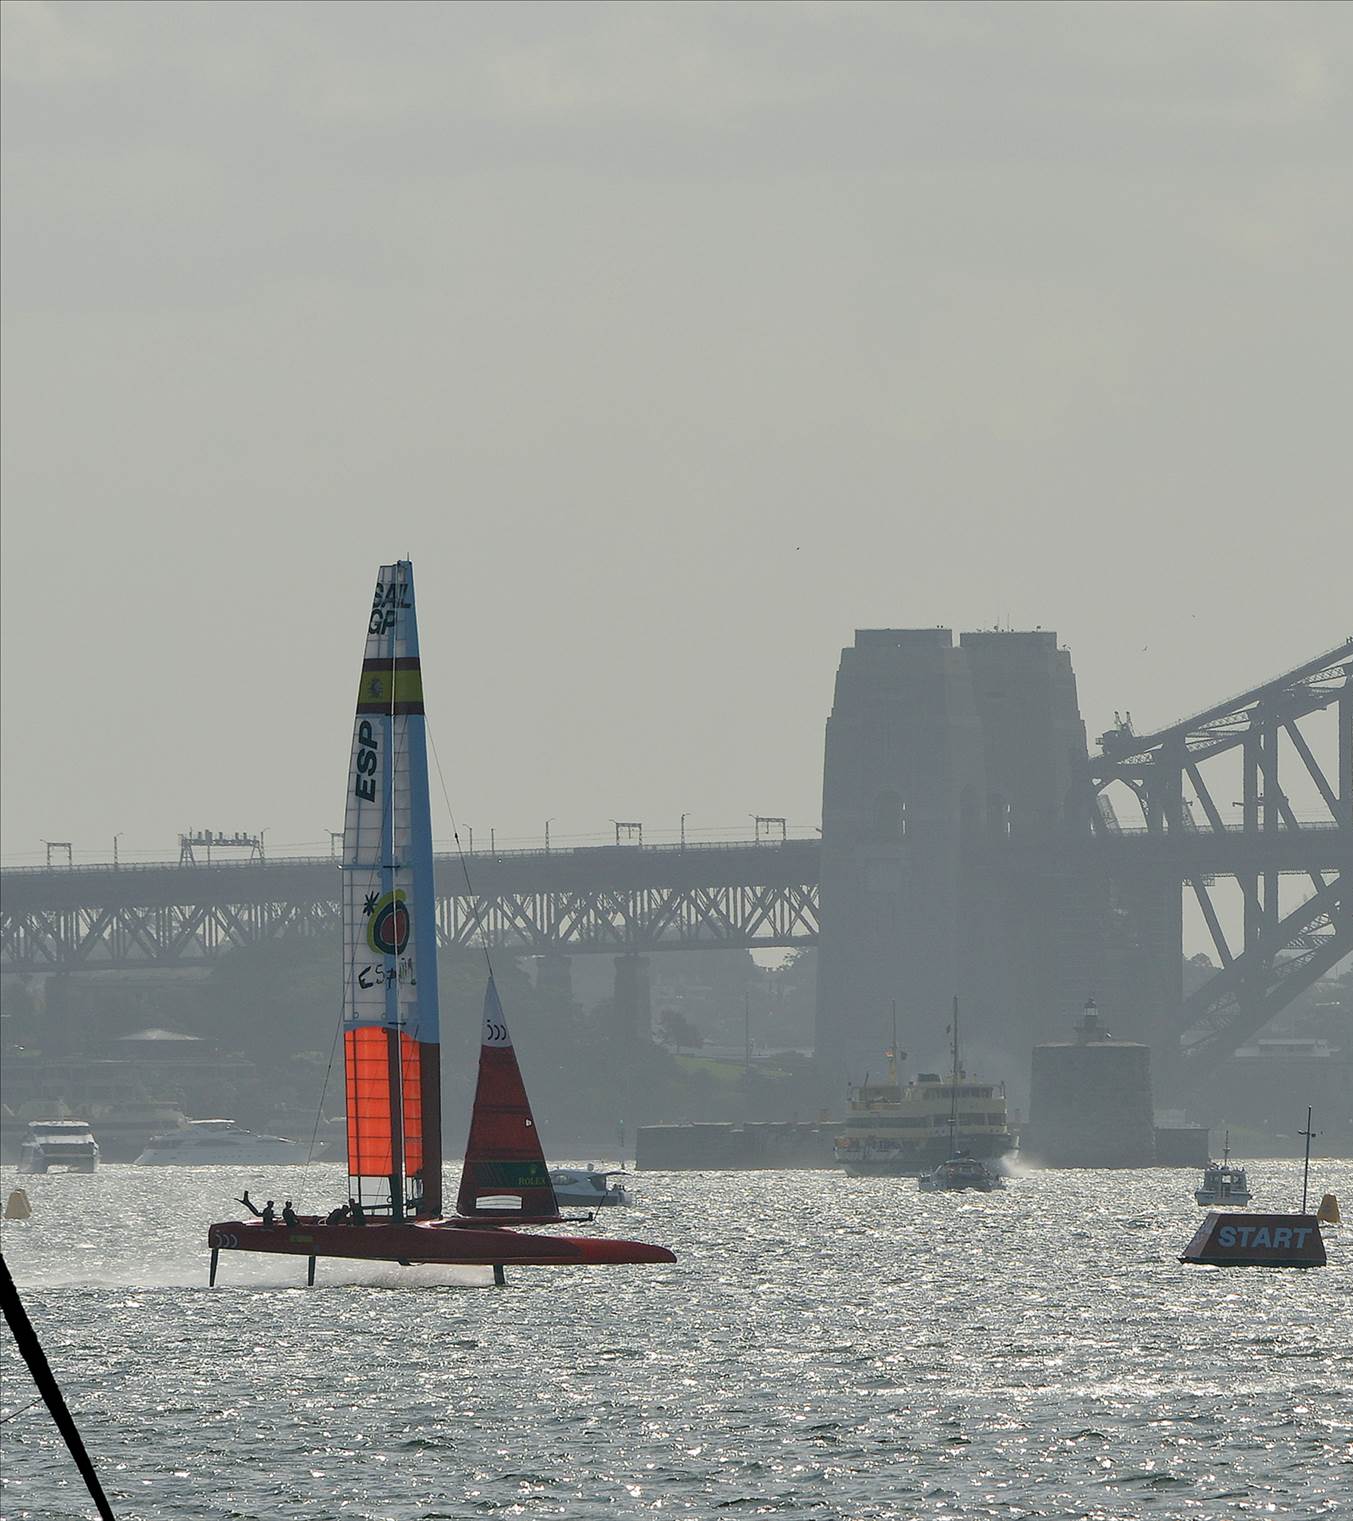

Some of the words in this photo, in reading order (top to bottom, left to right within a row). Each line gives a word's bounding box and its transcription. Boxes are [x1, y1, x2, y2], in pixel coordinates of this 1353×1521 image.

[372, 582, 412, 609] SAIL
[368, 608, 397, 635] GP
[355, 719, 378, 803] ESP
[1217, 1225, 1313, 1249] START
